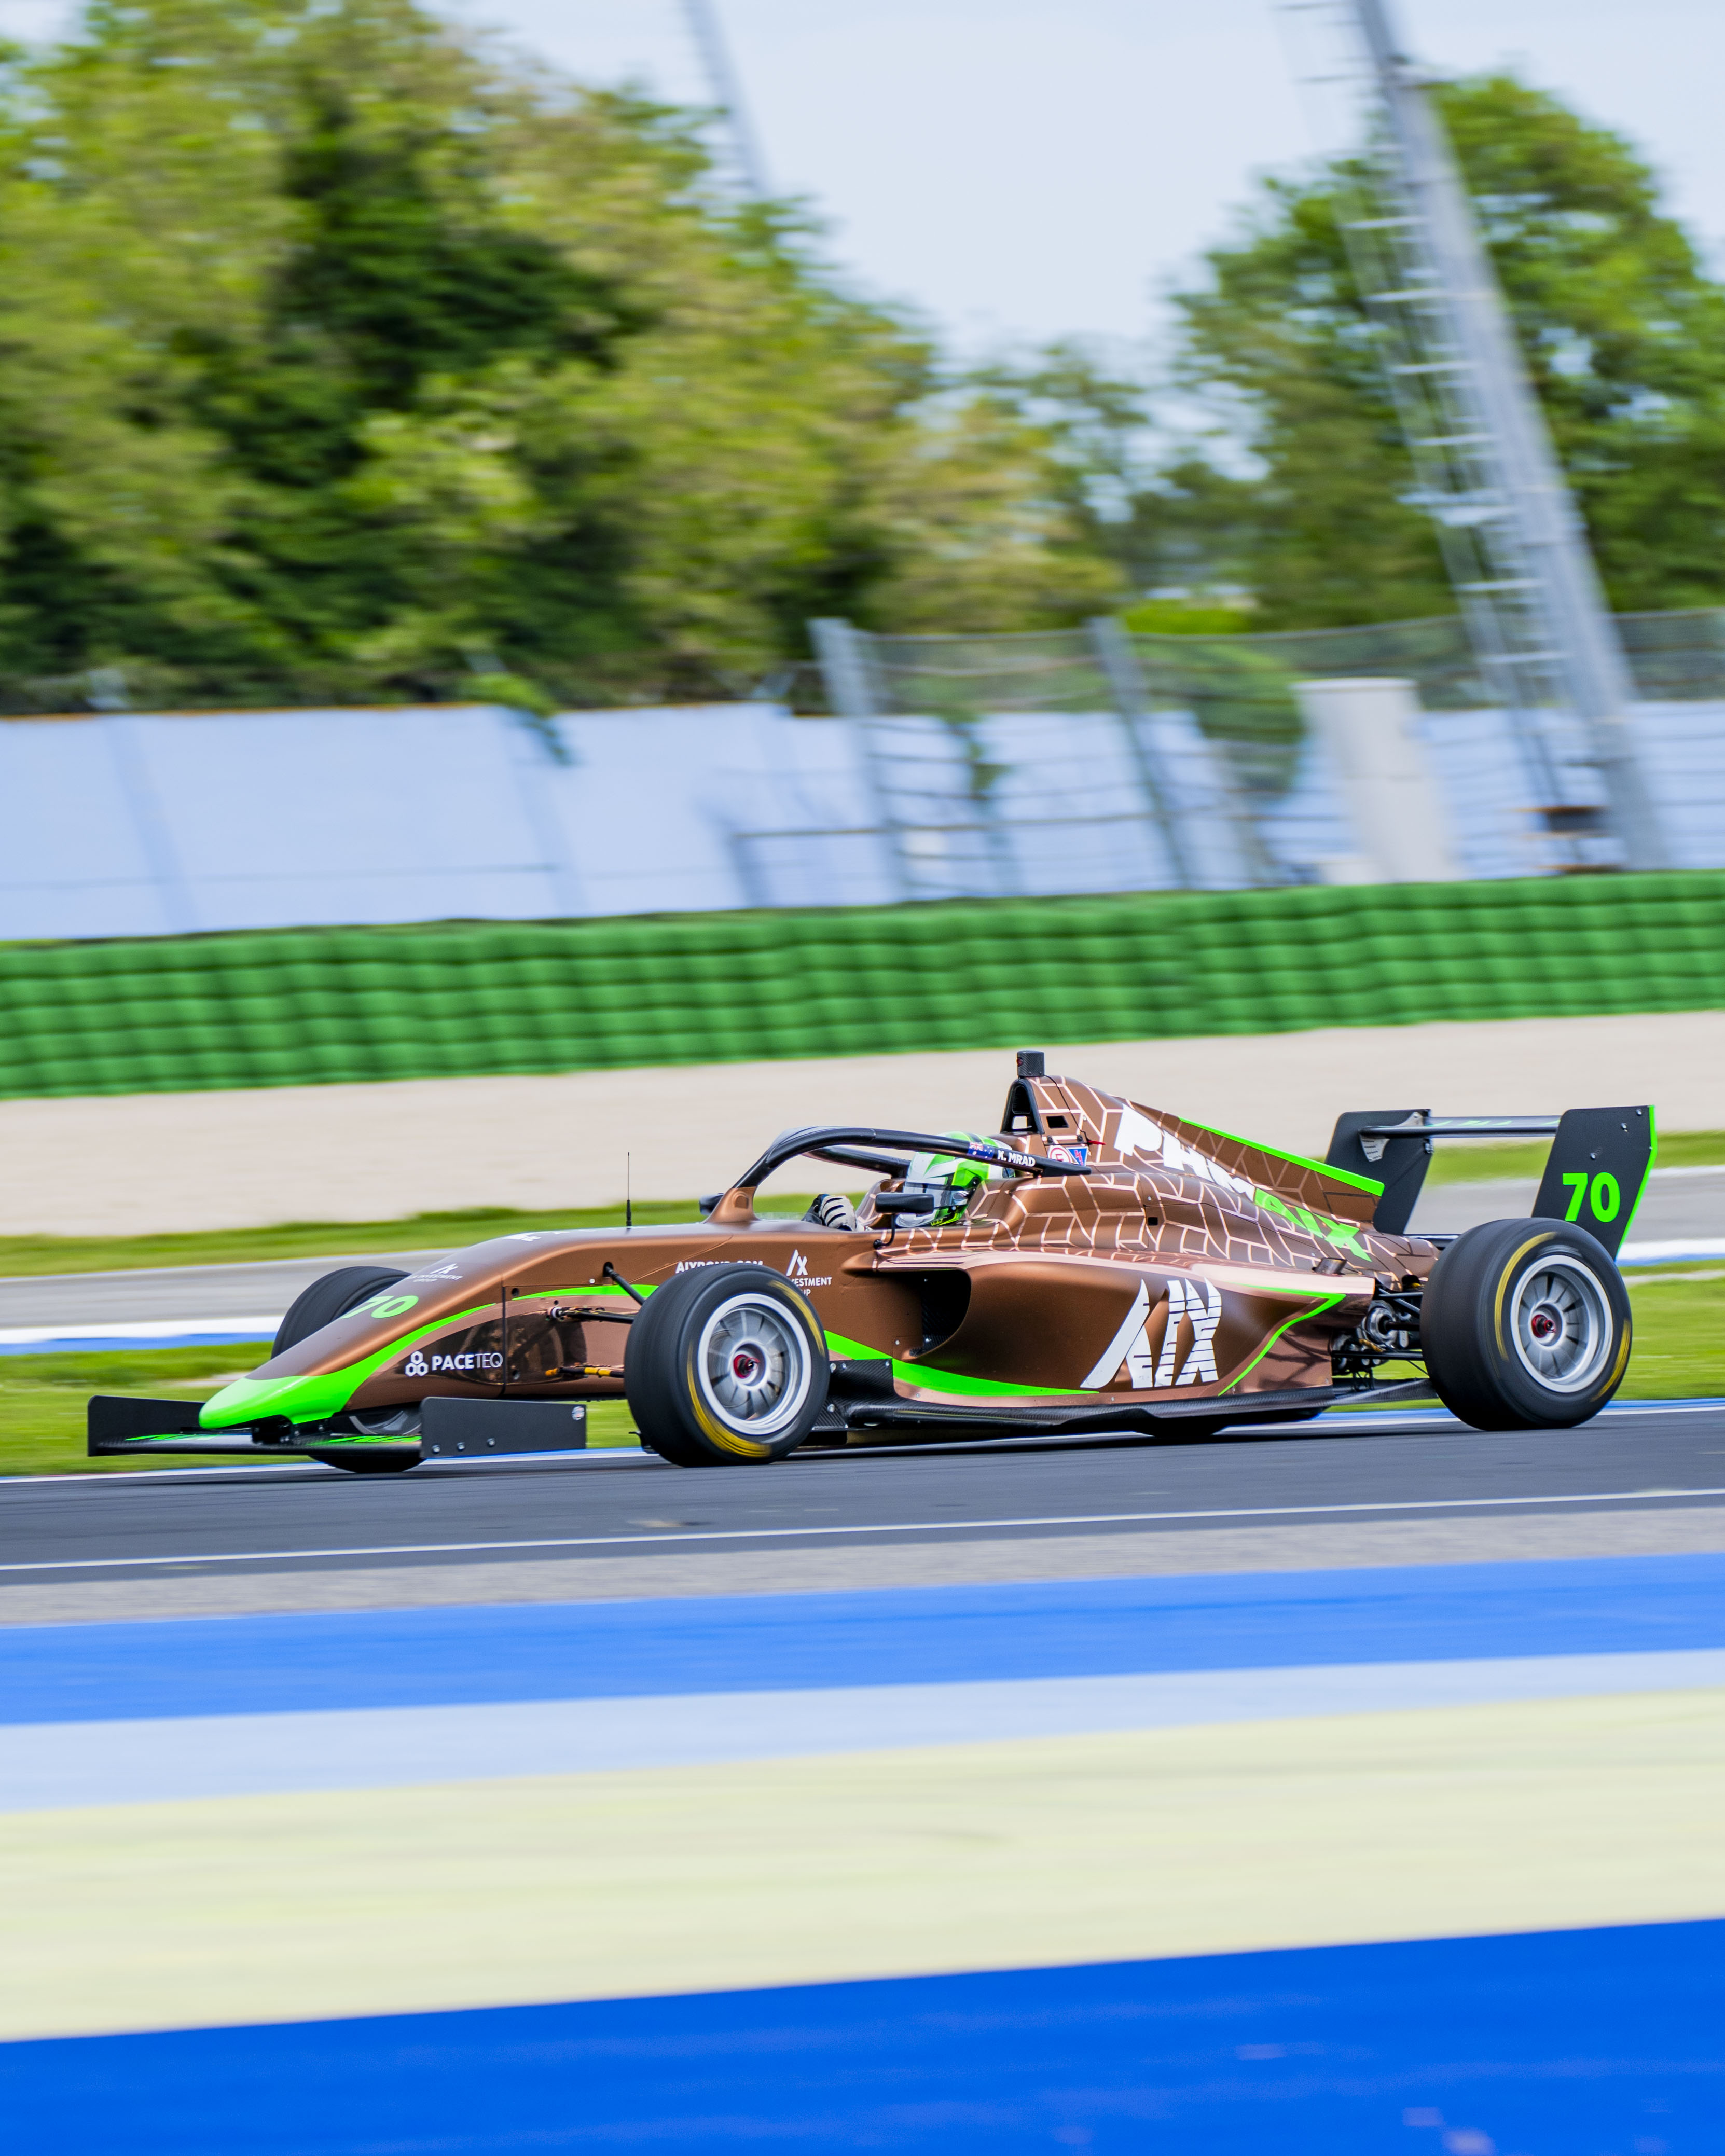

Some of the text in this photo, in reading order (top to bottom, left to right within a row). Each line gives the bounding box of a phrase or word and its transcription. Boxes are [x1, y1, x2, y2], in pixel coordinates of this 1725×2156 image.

[998, 1150, 1036, 1167] K. MRAD
[1563, 1172, 1621, 1223] 70
[792, 1277, 832, 1287] ESTMENT
[340, 1295, 419, 1319] 70
[432, 1352, 503, 1371] PACETEQ
